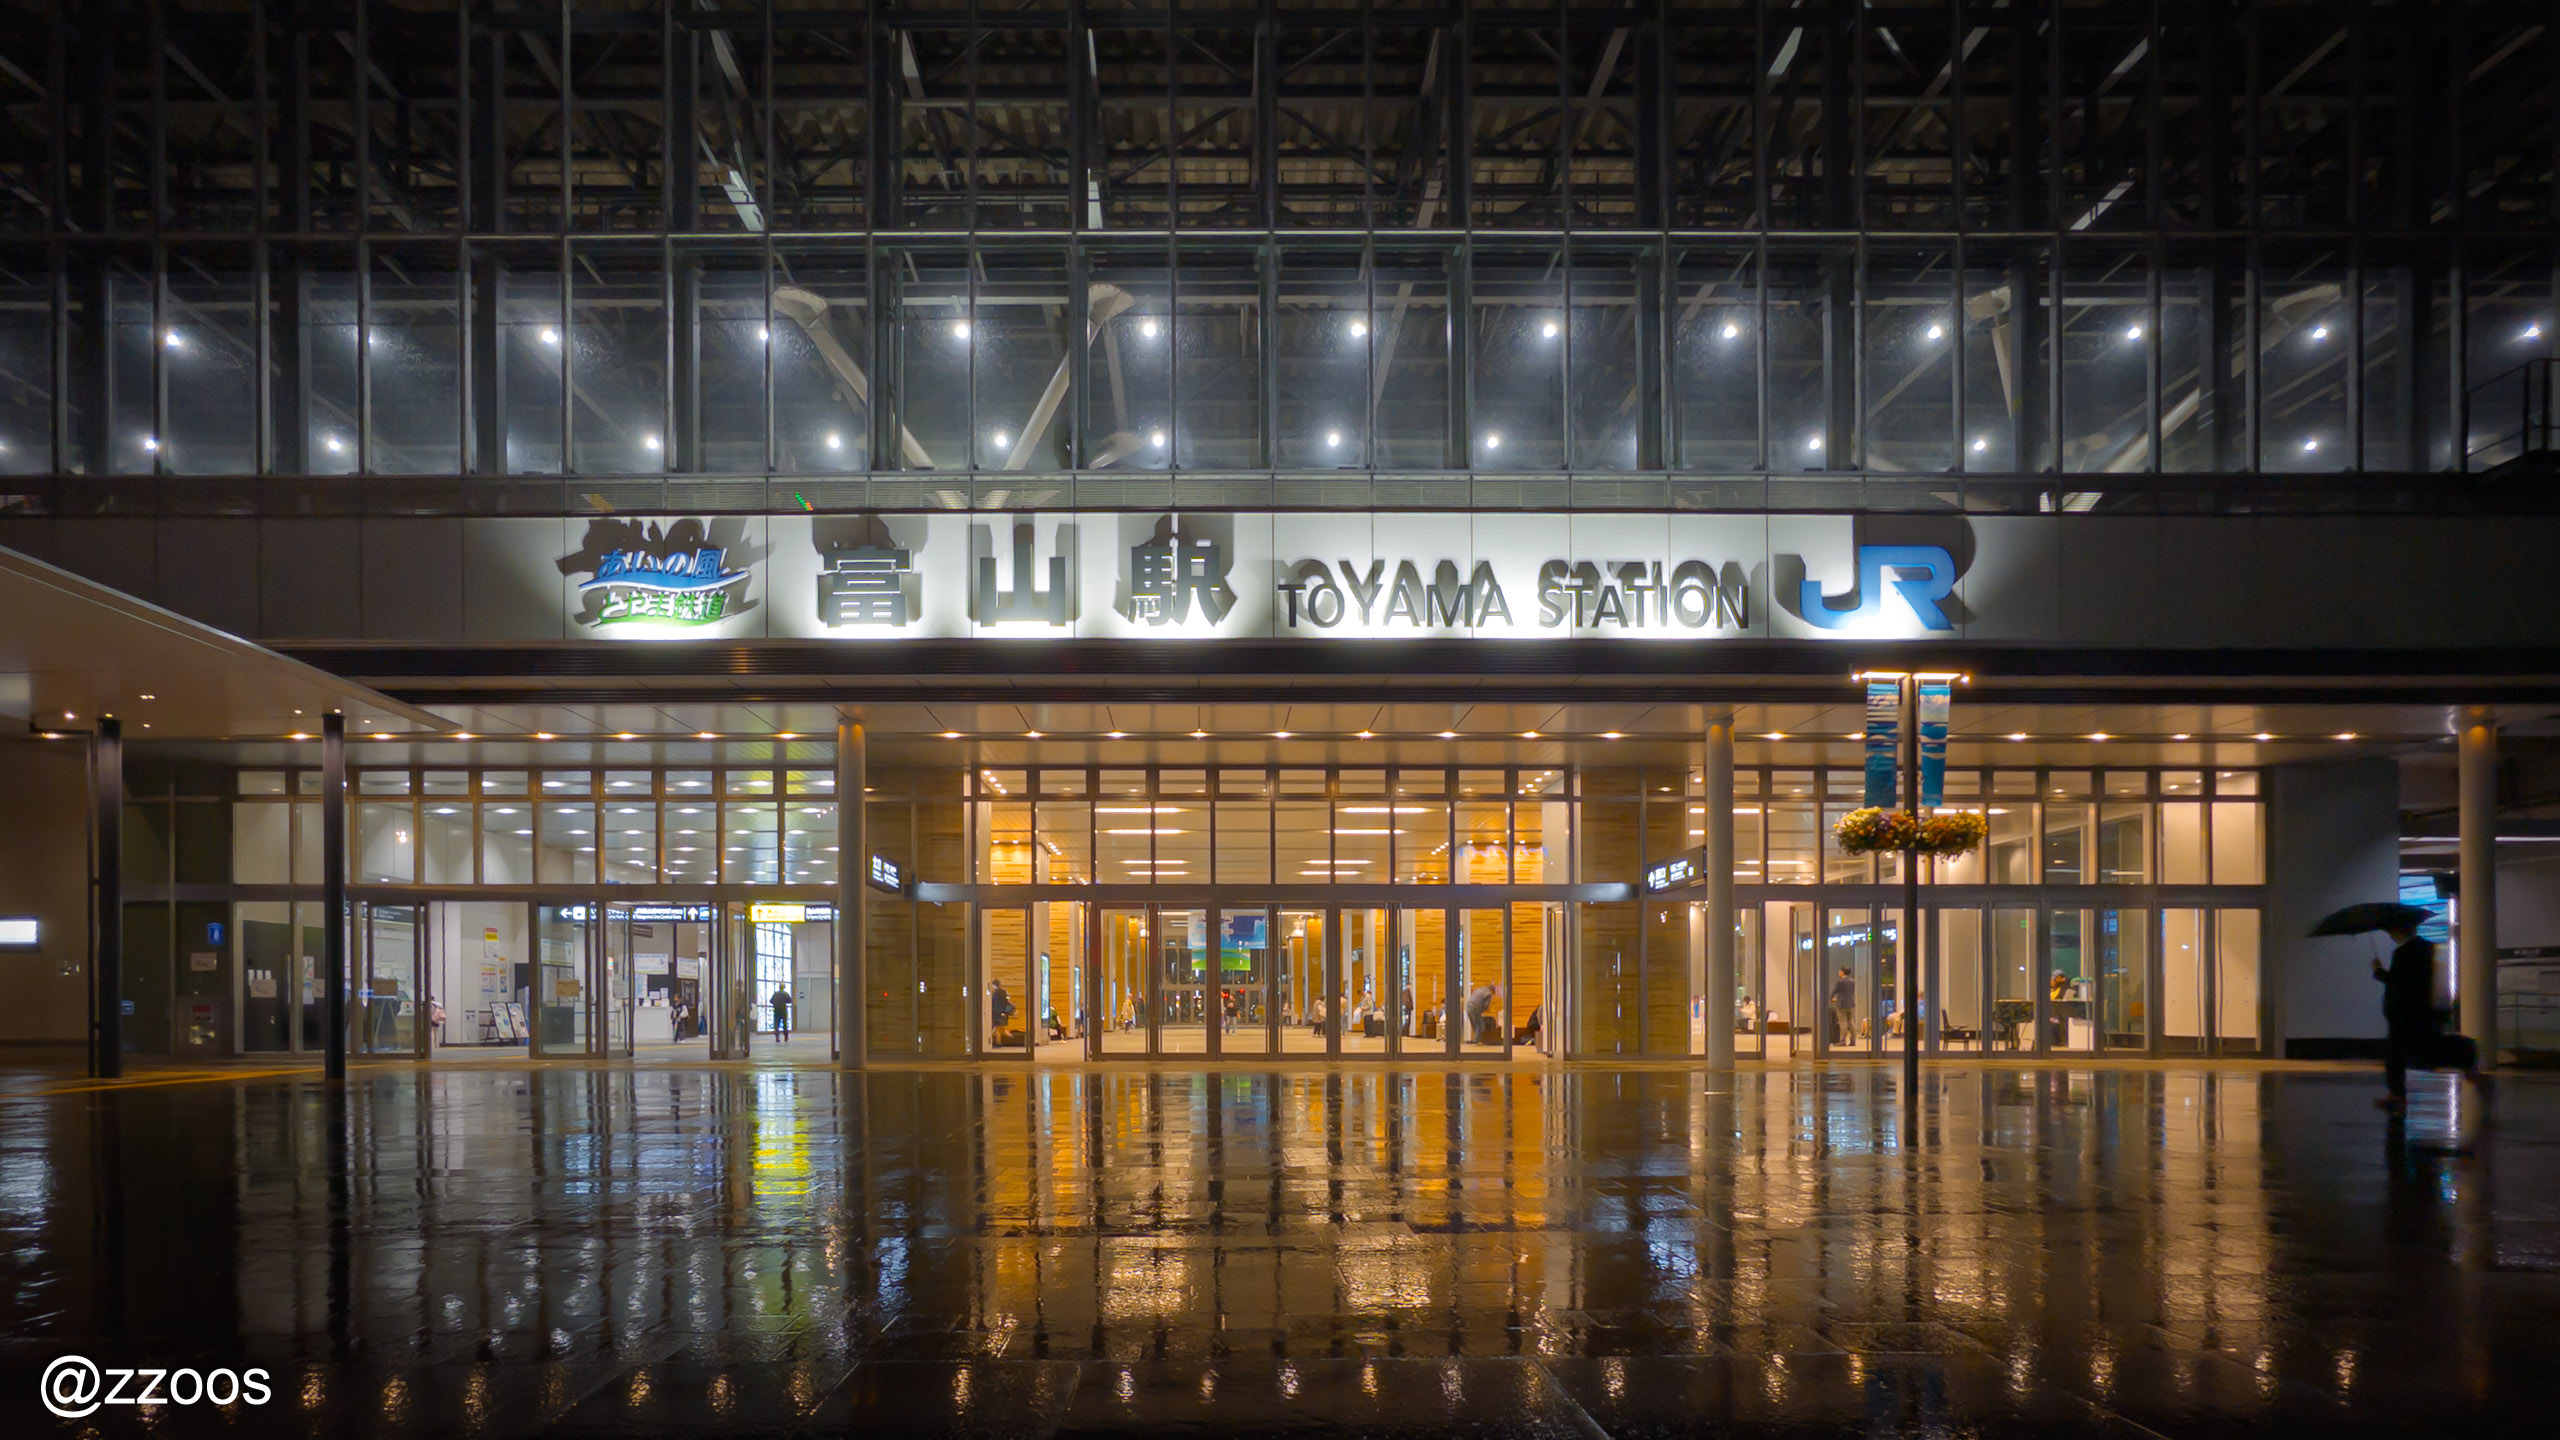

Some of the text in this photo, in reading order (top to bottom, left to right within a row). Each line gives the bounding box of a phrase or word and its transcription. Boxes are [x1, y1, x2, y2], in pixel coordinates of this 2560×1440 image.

[597, 548, 727, 579] あいの風
[823, 543, 1224, 628] 富山駅
[599, 590, 728, 622] とやま鉄道
[1278, 584, 1749, 629] TOYAMA STATION
[1800, 545, 1956, 631] JR
